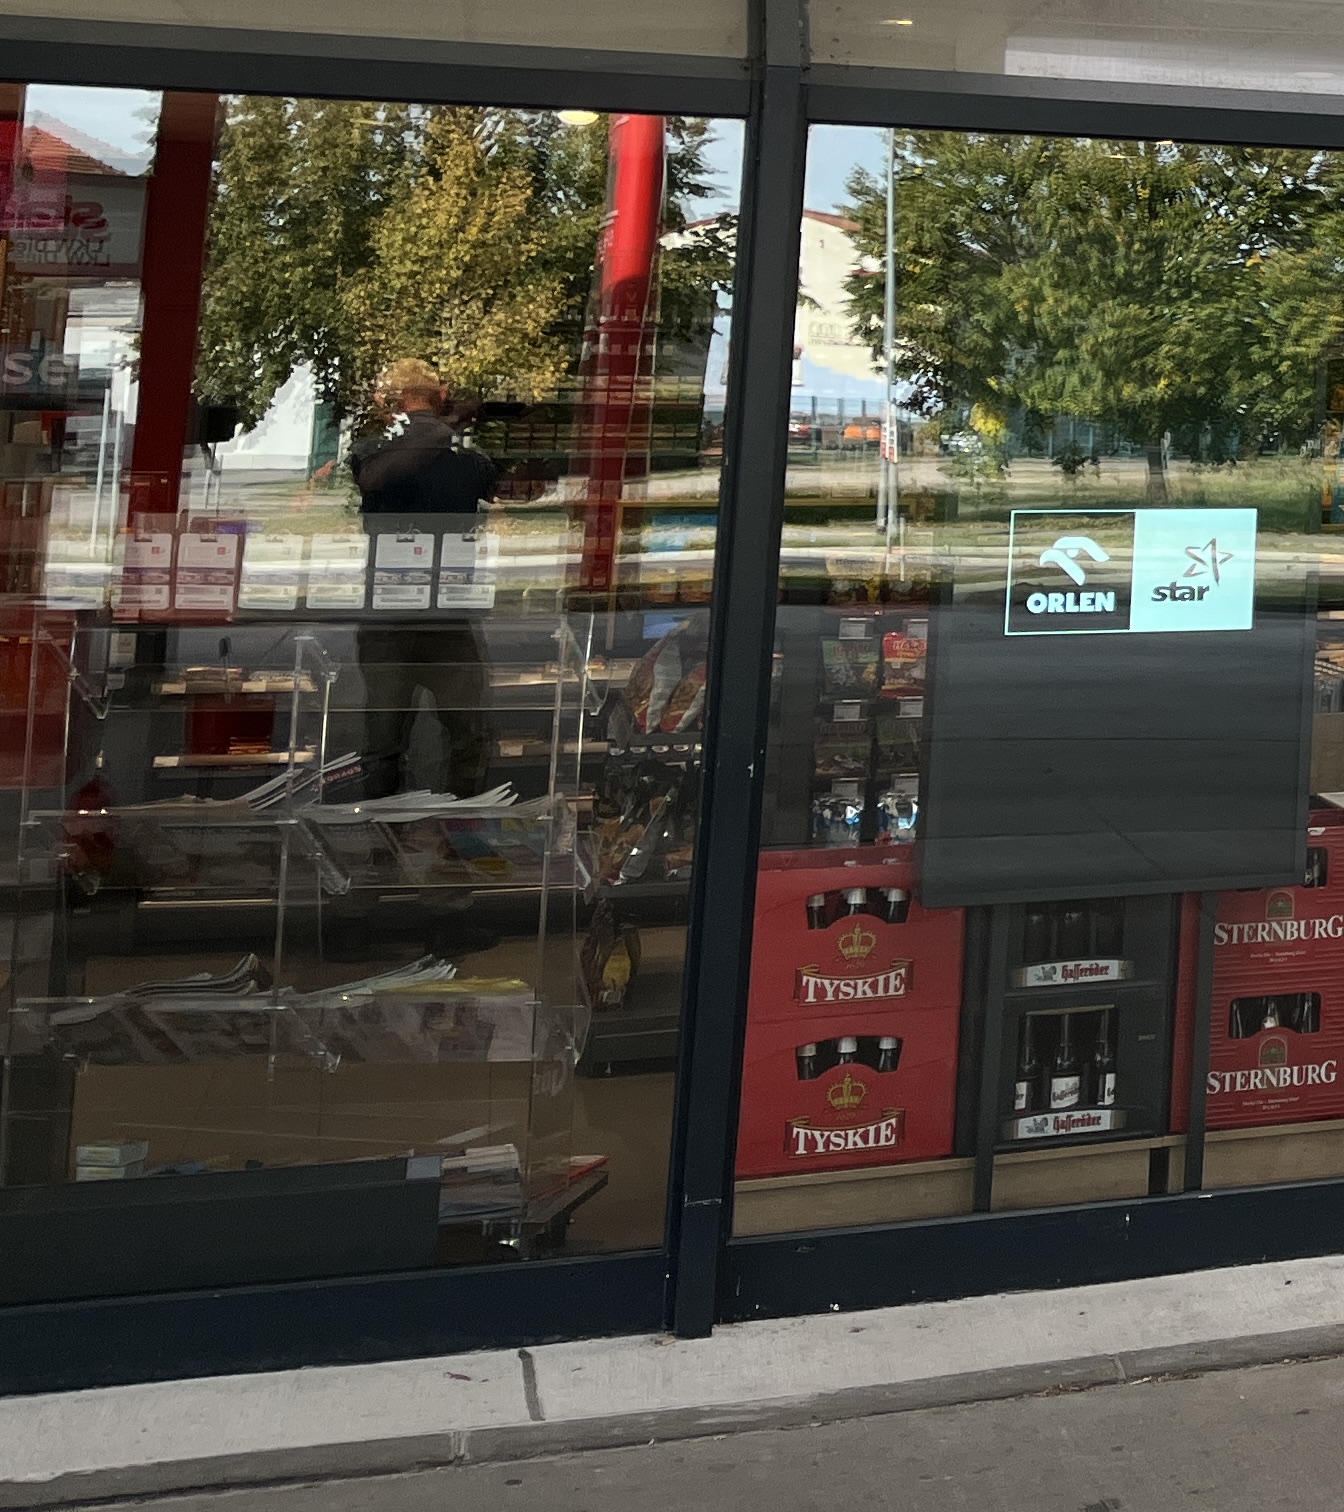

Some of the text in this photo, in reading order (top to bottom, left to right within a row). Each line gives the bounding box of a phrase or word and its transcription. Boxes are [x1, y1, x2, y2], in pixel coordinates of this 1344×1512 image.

[1026, 591, 1116, 614] ORLEN
[1151, 581, 1210, 602] star
[1213, 914, 1344, 946] STERNBURG
[802, 967, 906, 1004] TYSKIE
[1206, 1060, 1338, 1095] STERNBURG
[792, 1117, 898, 1155] TYSKIE
